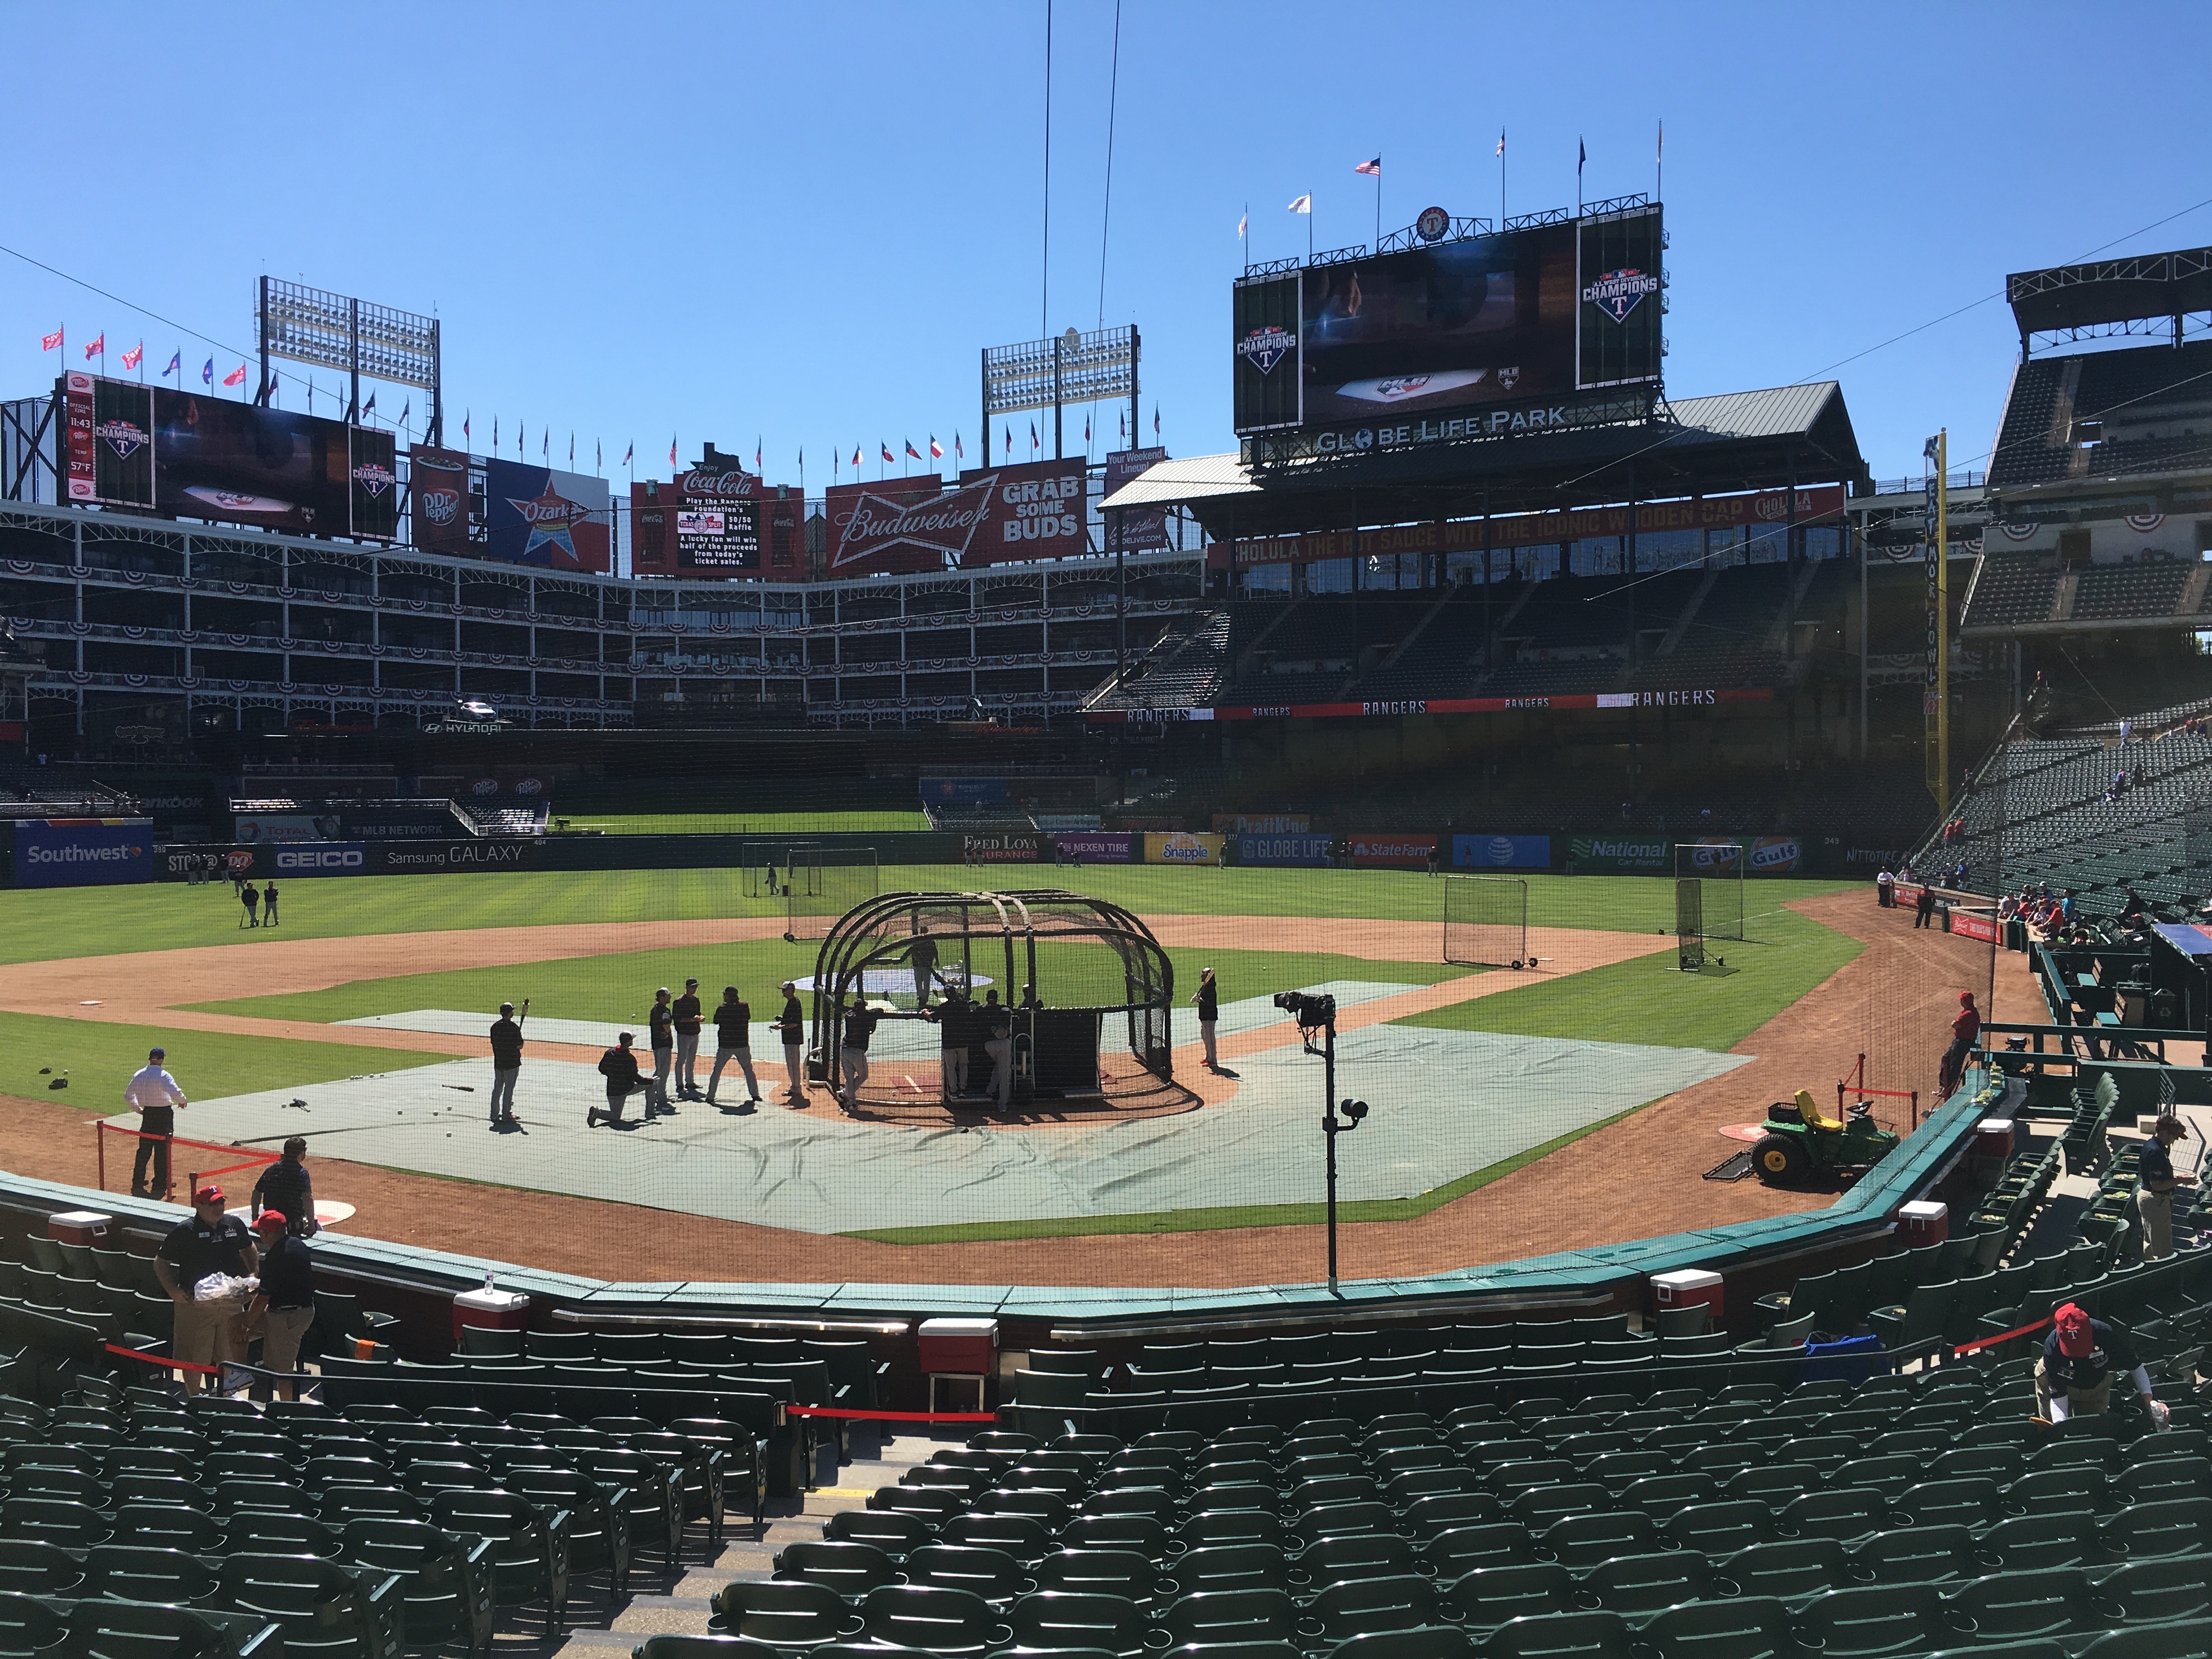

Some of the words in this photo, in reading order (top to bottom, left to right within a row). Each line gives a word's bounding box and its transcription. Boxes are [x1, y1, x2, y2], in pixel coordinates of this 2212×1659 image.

[1427, 217, 1438, 232] T
[1621, 274, 1646, 283] DIVISION
[1583, 278, 1657, 302] CHAMPIONS
[1612, 296, 1628, 315] T
[1237, 335, 1296, 355] CHAMPIONS
[1260, 351, 1272, 367] T
[1500, 368, 1518, 376] MLB
[1380, 376, 1429, 388] MLB
[69, 402, 91, 410] OFFICIAL
[71, 417, 90, 428] 11:43
[1421, 417, 1480, 439] LIFE
[1490, 407, 1565, 432] PARK
[96, 426, 149, 444] CHAMPIONS
[117, 439, 128, 454] T
[1108, 455, 1125, 465] Your
[1126, 449, 1162, 462] Weekend
[71, 461, 91, 472] 57°F
[699, 464, 719, 472] Enjoy
[1121, 462, 1149, 474] Lineup!
[353, 469, 395, 484] CHAMPIONS
[683, 470, 753, 495] Coca-Cola
[370, 481, 379, 493] T
[1003, 476, 1079, 504] GRAB
[422, 493, 458, 522] Pepper
[435, 493, 451, 507] Dr
[686, 497, 703, 505] Play
[524, 501, 577, 522] Ozarka
[1015, 499, 1065, 518] SOME
[1927, 482, 1936, 534] EAT
[834, 504, 990, 543] Budweiser
[1004, 515, 1078, 542] BUDS
[1306, 538, 1335, 555] THE
[1380, 527, 1436, 549] SAUCE
[1496, 519, 1530, 540] THE
[1538, 513, 1600, 537] ICONIC
[1703, 500, 1743, 523] CAP
[688, 535, 708, 544] lucky
[1111, 534, 1161, 546] GDELIVE.COM
[715, 551, 743, 560] today's
[724, 544, 758, 552] proceeds
[1928, 546, 1937, 599] MOR
[1927, 611, 1937, 682] FOWL
[1505, 698, 1549, 708] RANGERS
[1632, 690, 1716, 706] RANGERS
[1253, 707, 1290, 717] RANGERS
[1363, 701, 1426, 715] RANGERS
[1128, 709, 1189, 723] RANGERS
[447, 724, 501, 733] HYUNDAI
[266, 826, 312, 835] TOTAL
[362, 826, 386, 835] MLB
[389, 825, 443, 834] NETWORK
[964, 836, 1000, 849] FRED
[1003, 835, 1037, 849] LOYA
[1074, 843, 1105, 852] NEXEN
[1107, 843, 1128, 852] TIRE
[1258, 839, 1300, 857] GLOBE
[1304, 839, 1329, 857] LIFE
[1592, 841, 1666, 857] National
[27, 844, 128, 863] Southwest
[276, 851, 363, 868] GEICO
[388, 852, 445, 865] Samsung
[450, 845, 523, 863] GALAXY
[1164, 844, 1207, 861] Snapple
[1696, 846, 1739, 864] Glf
[1754, 845, 1796, 864] Gulf
[228, 856, 249, 867] DQ
[2068, 1330, 2078, 1339] T
